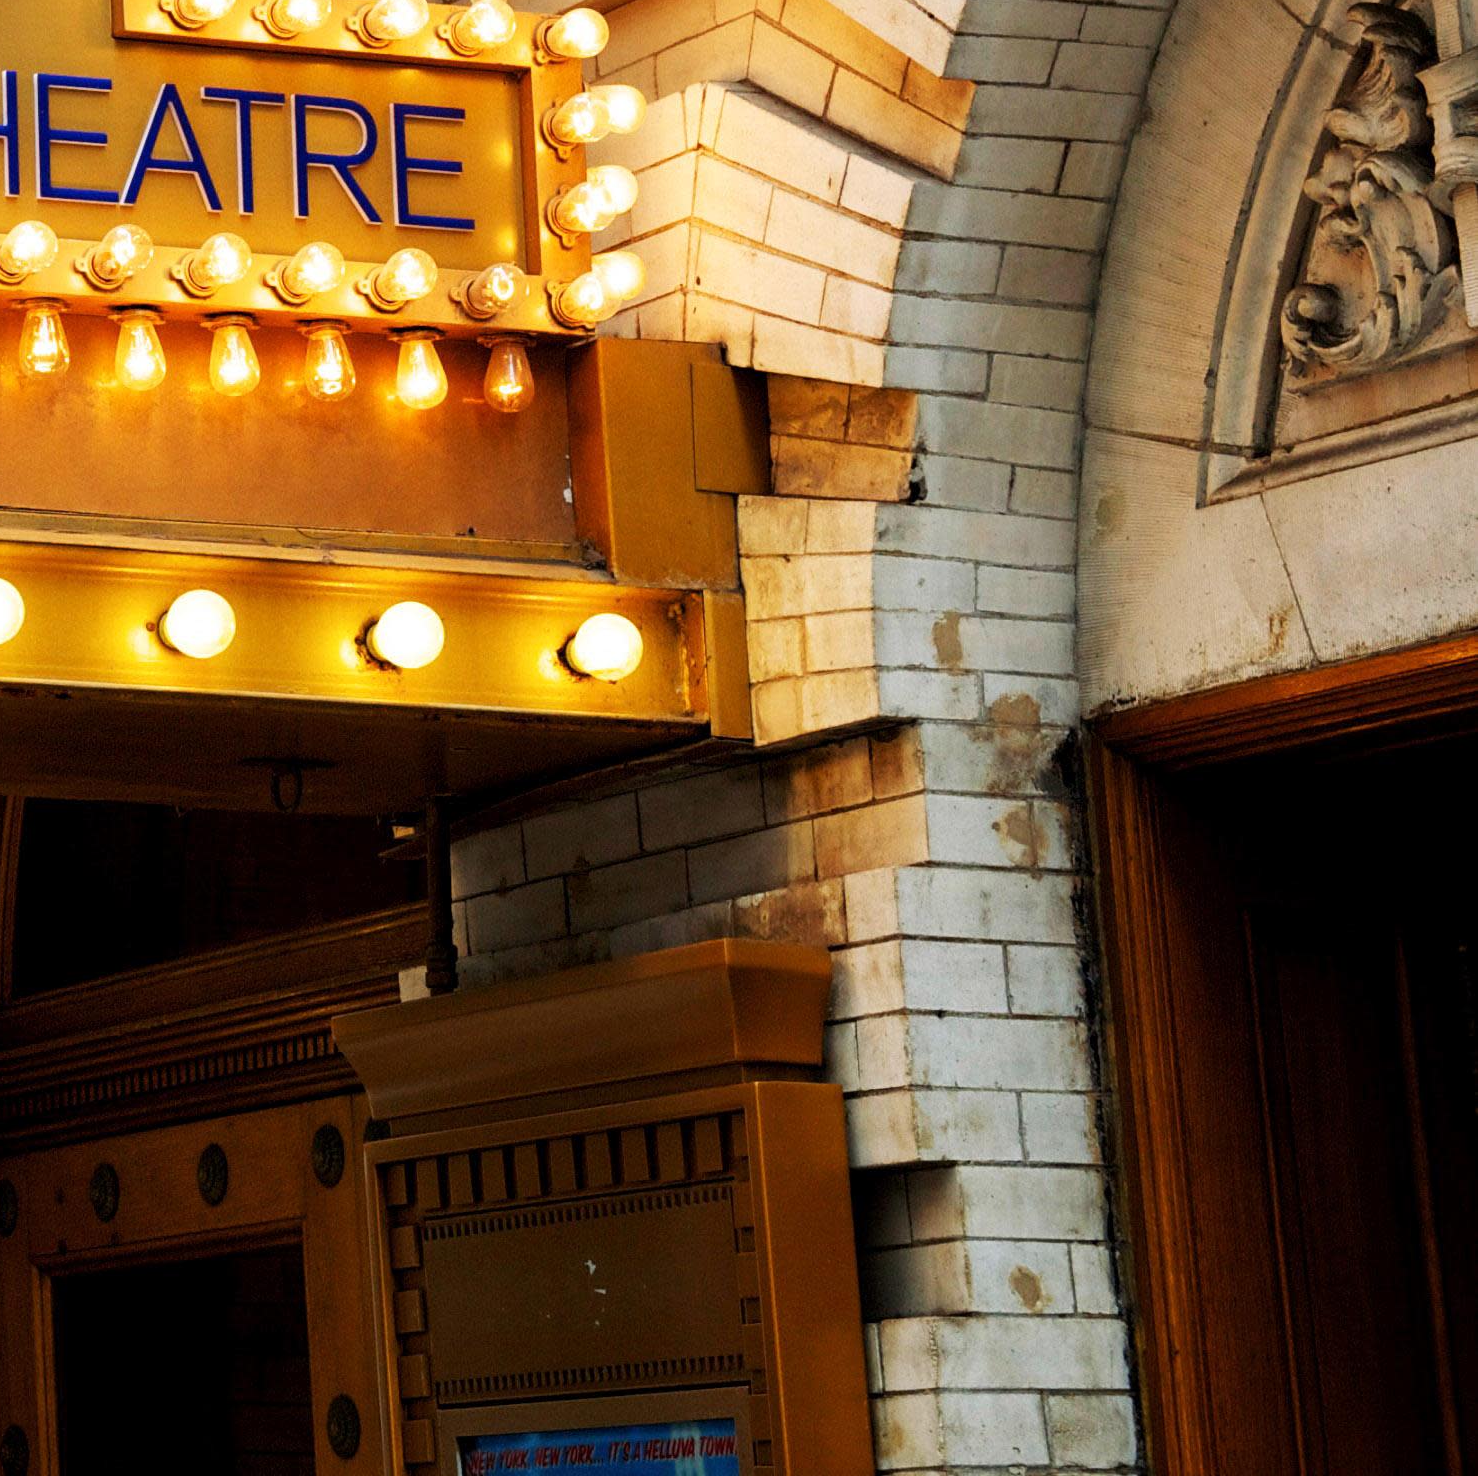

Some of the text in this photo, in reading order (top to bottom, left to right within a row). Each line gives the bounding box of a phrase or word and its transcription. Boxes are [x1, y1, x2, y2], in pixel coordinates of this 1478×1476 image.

[534, 1445, 561, 1467] NEW
[608, 1440, 631, 1463] IT'S
[632, 1440, 643, 1460] A
[644, 1435, 697, 1460] HELLUVA
